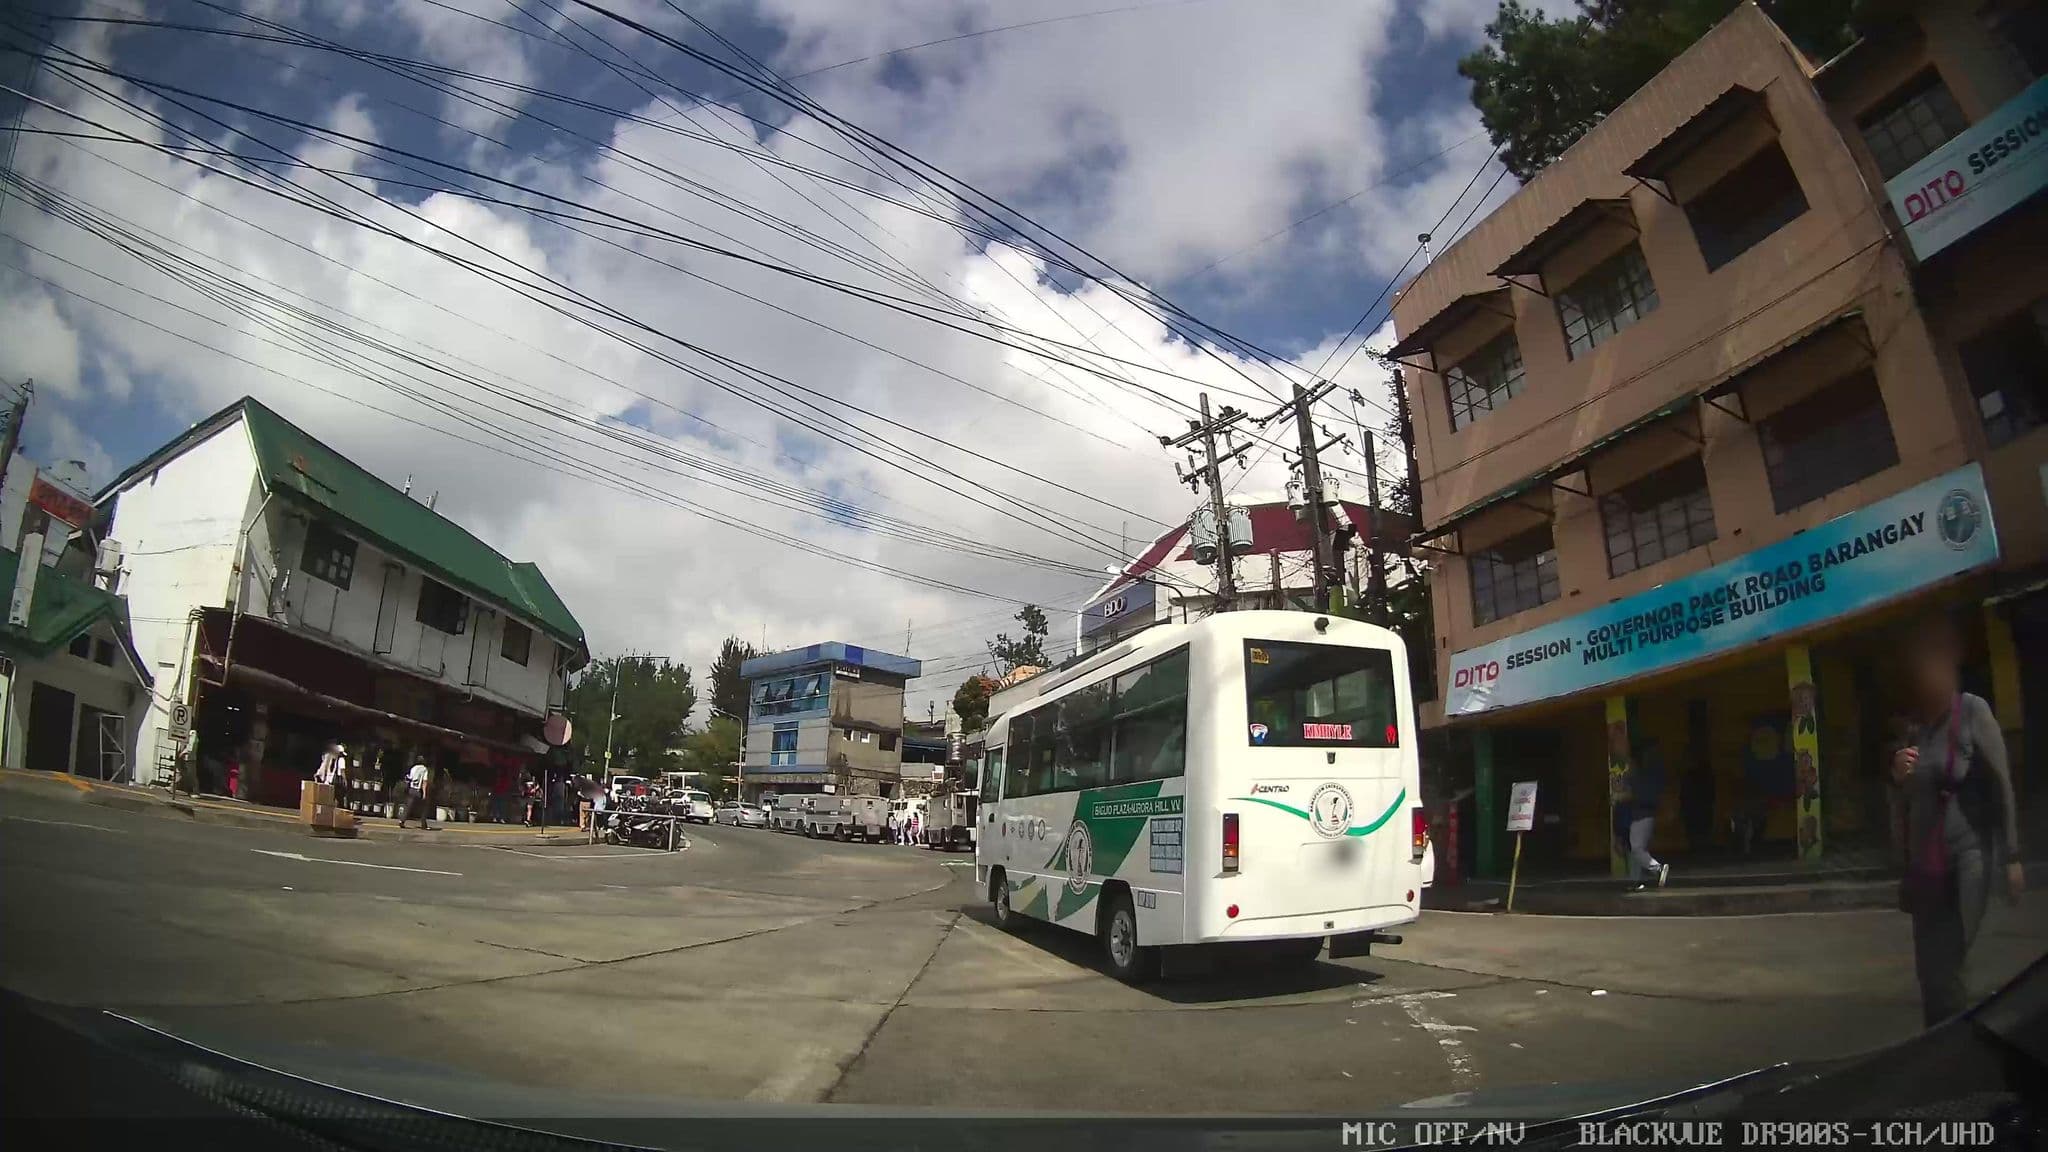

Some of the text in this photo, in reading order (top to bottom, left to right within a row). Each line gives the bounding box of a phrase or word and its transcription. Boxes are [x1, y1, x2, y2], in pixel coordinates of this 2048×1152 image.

[1904, 170, 1964, 220] DITO
[1105, 597, 1126, 617] BDO
[1455, 661, 1499, 688] DITO
[1506, 637, 1571, 670] SESSION
[1586, 602, 1684, 646] GOVERNOR
[1689, 582, 1740, 611] PACK
[1745, 560, 1802, 596] ROAD
[1808, 512, 1925, 573] BARANGAY
[1583, 573, 1826, 665] MULTI PURPOSE BUILDING
[1154, 800, 1169, 812] HILL
